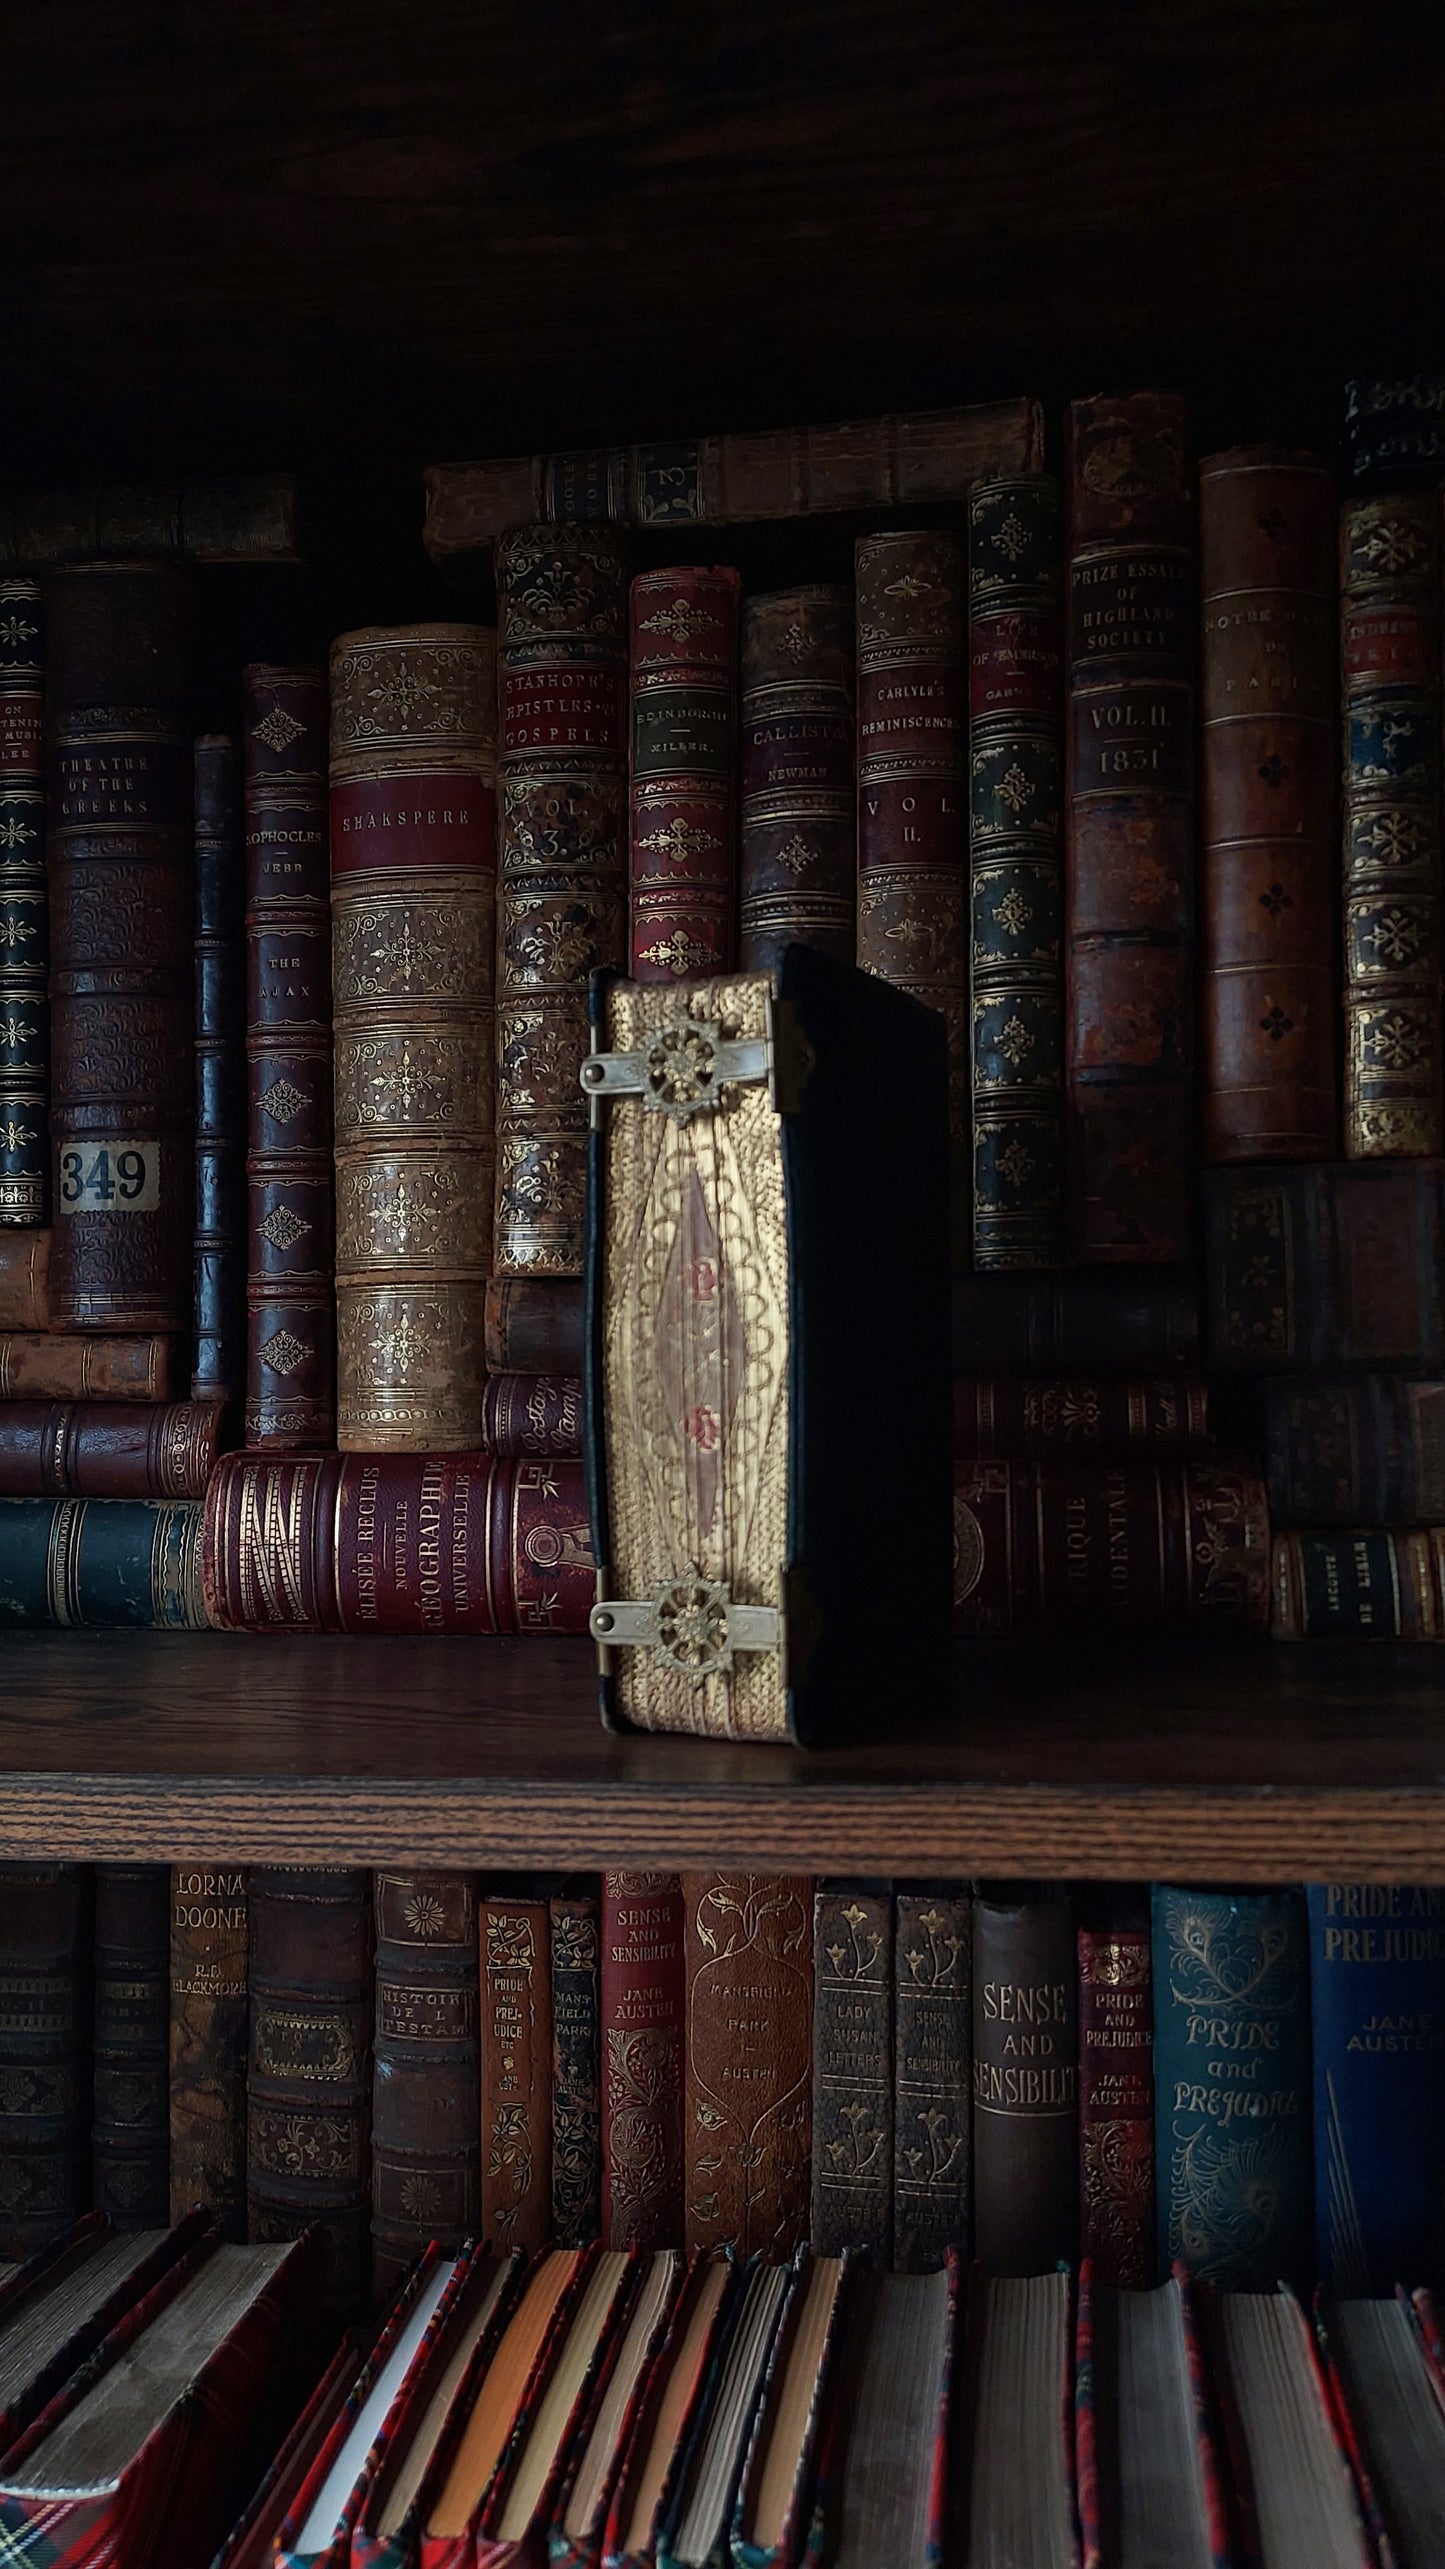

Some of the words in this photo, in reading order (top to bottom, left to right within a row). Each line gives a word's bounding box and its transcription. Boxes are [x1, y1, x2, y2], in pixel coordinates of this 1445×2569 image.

[1072, 564, 1119, 587] PRIZE
[1117, 586, 1137, 601] OF
[1087, 630, 1169, 650] SOCIETY
[506, 673, 615, 695] STANHOPE'S
[877, 680, 944, 700] CARLYLE'S
[5, 705, 21, 715] ON
[506, 727, 609, 746] GOSPELS
[753, 724, 847, 746] CALLISTA
[60, 757, 147, 773] THEATRE
[1100, 748, 1160, 774] 1831
[767, 766, 827, 782] NEWMAN
[69, 779, 88, 792] OF
[99, 778, 133, 791] THE
[62, 799, 148, 815] GREEKS
[343, 809, 469, 832] SHAKSPERE
[246, 829, 322, 847] SOPHOCLES
[269, 957, 301, 969] THE
[260, 985, 312, 998] AJAX
[62, 1150, 146, 1202] 349
[357, 1467, 379, 1542] RECLUS
[395, 1500, 407, 1590] NOUVELLE
[414, 1460, 447, 1627] GÉOGRAPHIE
[452, 1475, 470, 1613] UNIVERSELLE
[352, 1552, 378, 1620] ÉLISÉE
[176, 1873, 247, 1896] LORNA
[1326, 1885, 1401, 1919] PRIDE
[1410, 1886, 1445, 1920] AN
[176, 1905, 247, 1929] DOONE
[618, 1907, 671, 1926] SENSE
[628, 1929, 659, 1943] AND
[611, 1941, 676, 1962] SENSIBILITY
[494, 1978, 523, 1992] PRIDE
[623, 1986, 664, 2002] JANE
[501, 1995, 517, 2004] AND
[983, 1982, 1067, 2025] SENSE
[1095, 1993, 1143, 2010] PRIDE
[554, 2006, 591, 2019] FIELD
[615, 2000, 674, 2020] AUSTEN
[837, 2005, 871, 2019] LADY
[727, 2018, 770, 2033] PARK
[1104, 2013, 1136, 2028] AND
[1361, 2013, 1433, 2031] JANE
[493, 2023, 522, 2039] UDICE
[556, 2023, 592, 2037] PARK
[833, 2028, 876, 2043] SUSAN
[1086, 2030, 1152, 2048] PREJUDICE
[1185, 2014, 1279, 2050] PRIDE
[1003, 2034, 1053, 2056] AND
[829, 2050, 881, 2067] LETTERS
[906, 2056, 961, 2074] SENSIBILITY
[722, 2066, 776, 2080] AUSTEN
[1207, 2057, 1264, 2079] and
[973, 2058, 1074, 2105] SENSIBILIT
[1098, 2073, 1142, 2087] JANE
[1090, 2090, 1150, 2105] AUSTEN
[1173, 2081, 1298, 2127] PREJUDICE
